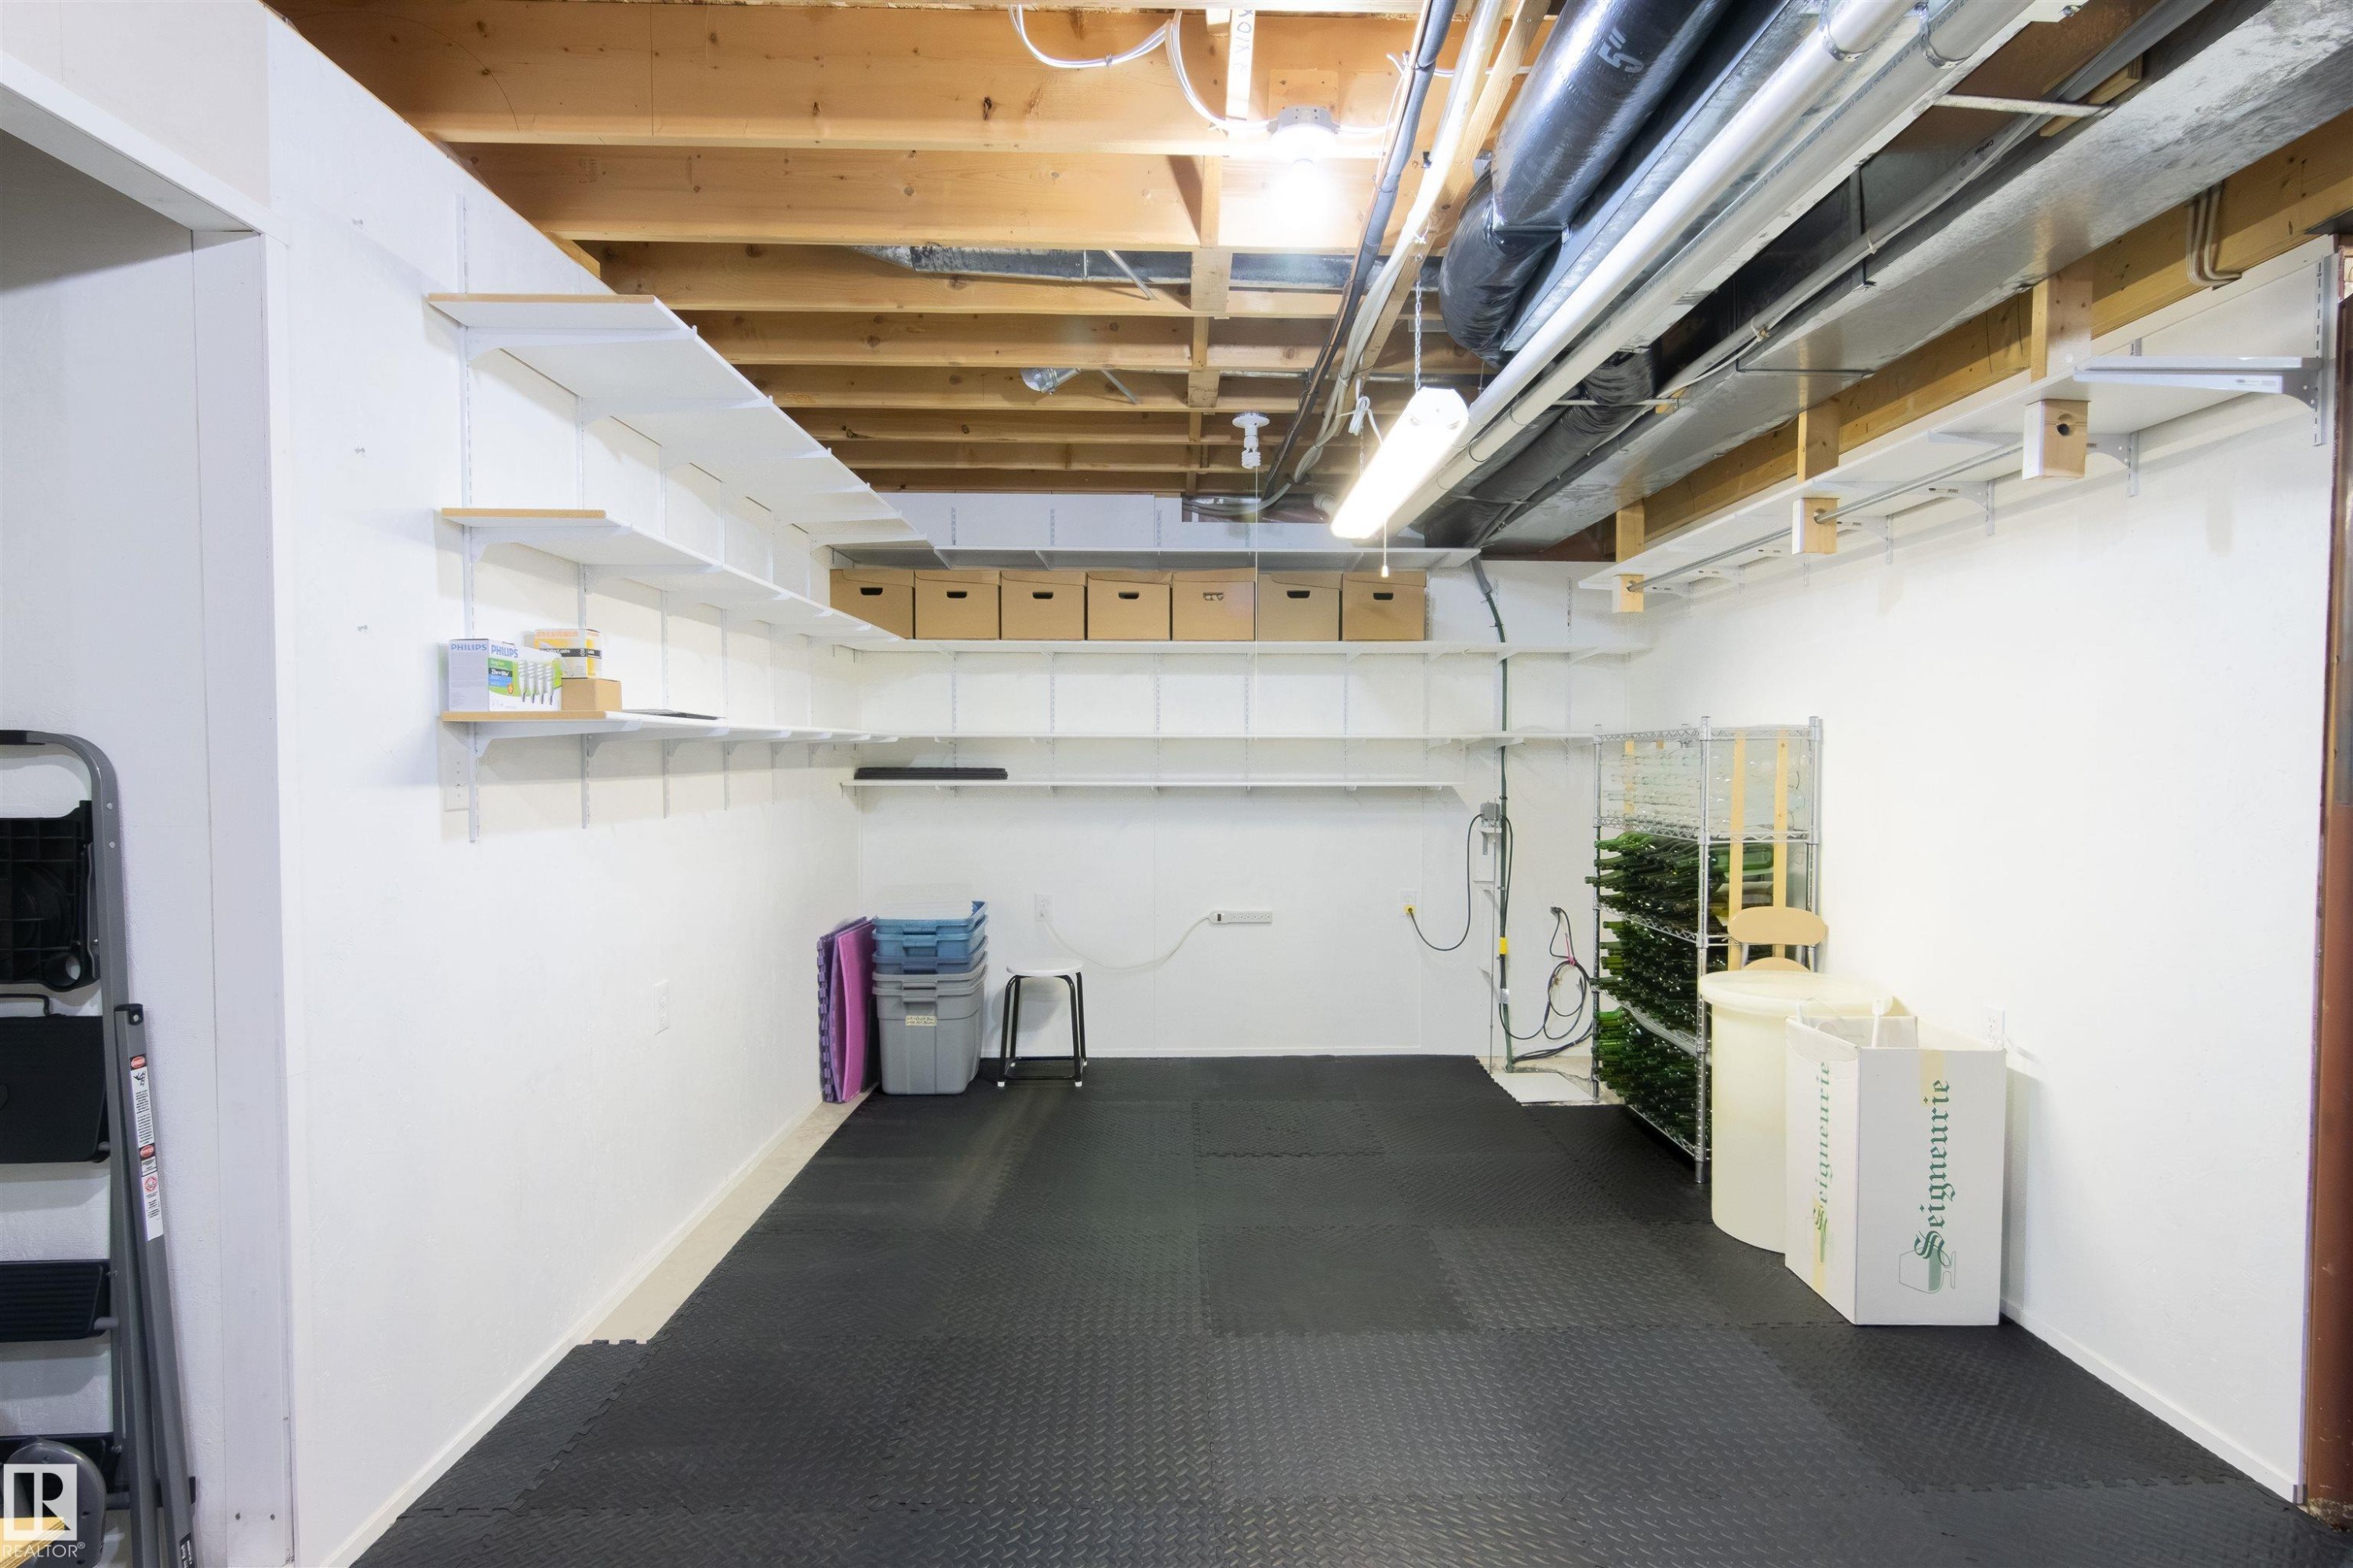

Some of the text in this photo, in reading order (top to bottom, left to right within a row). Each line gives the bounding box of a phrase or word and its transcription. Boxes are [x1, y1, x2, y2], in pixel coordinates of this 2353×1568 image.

[491, 644, 518, 658] PHILIPS
[1813, 1062, 1833, 1239] Seigneurie
[1914, 1079, 1956, 1268] Seigneurie
